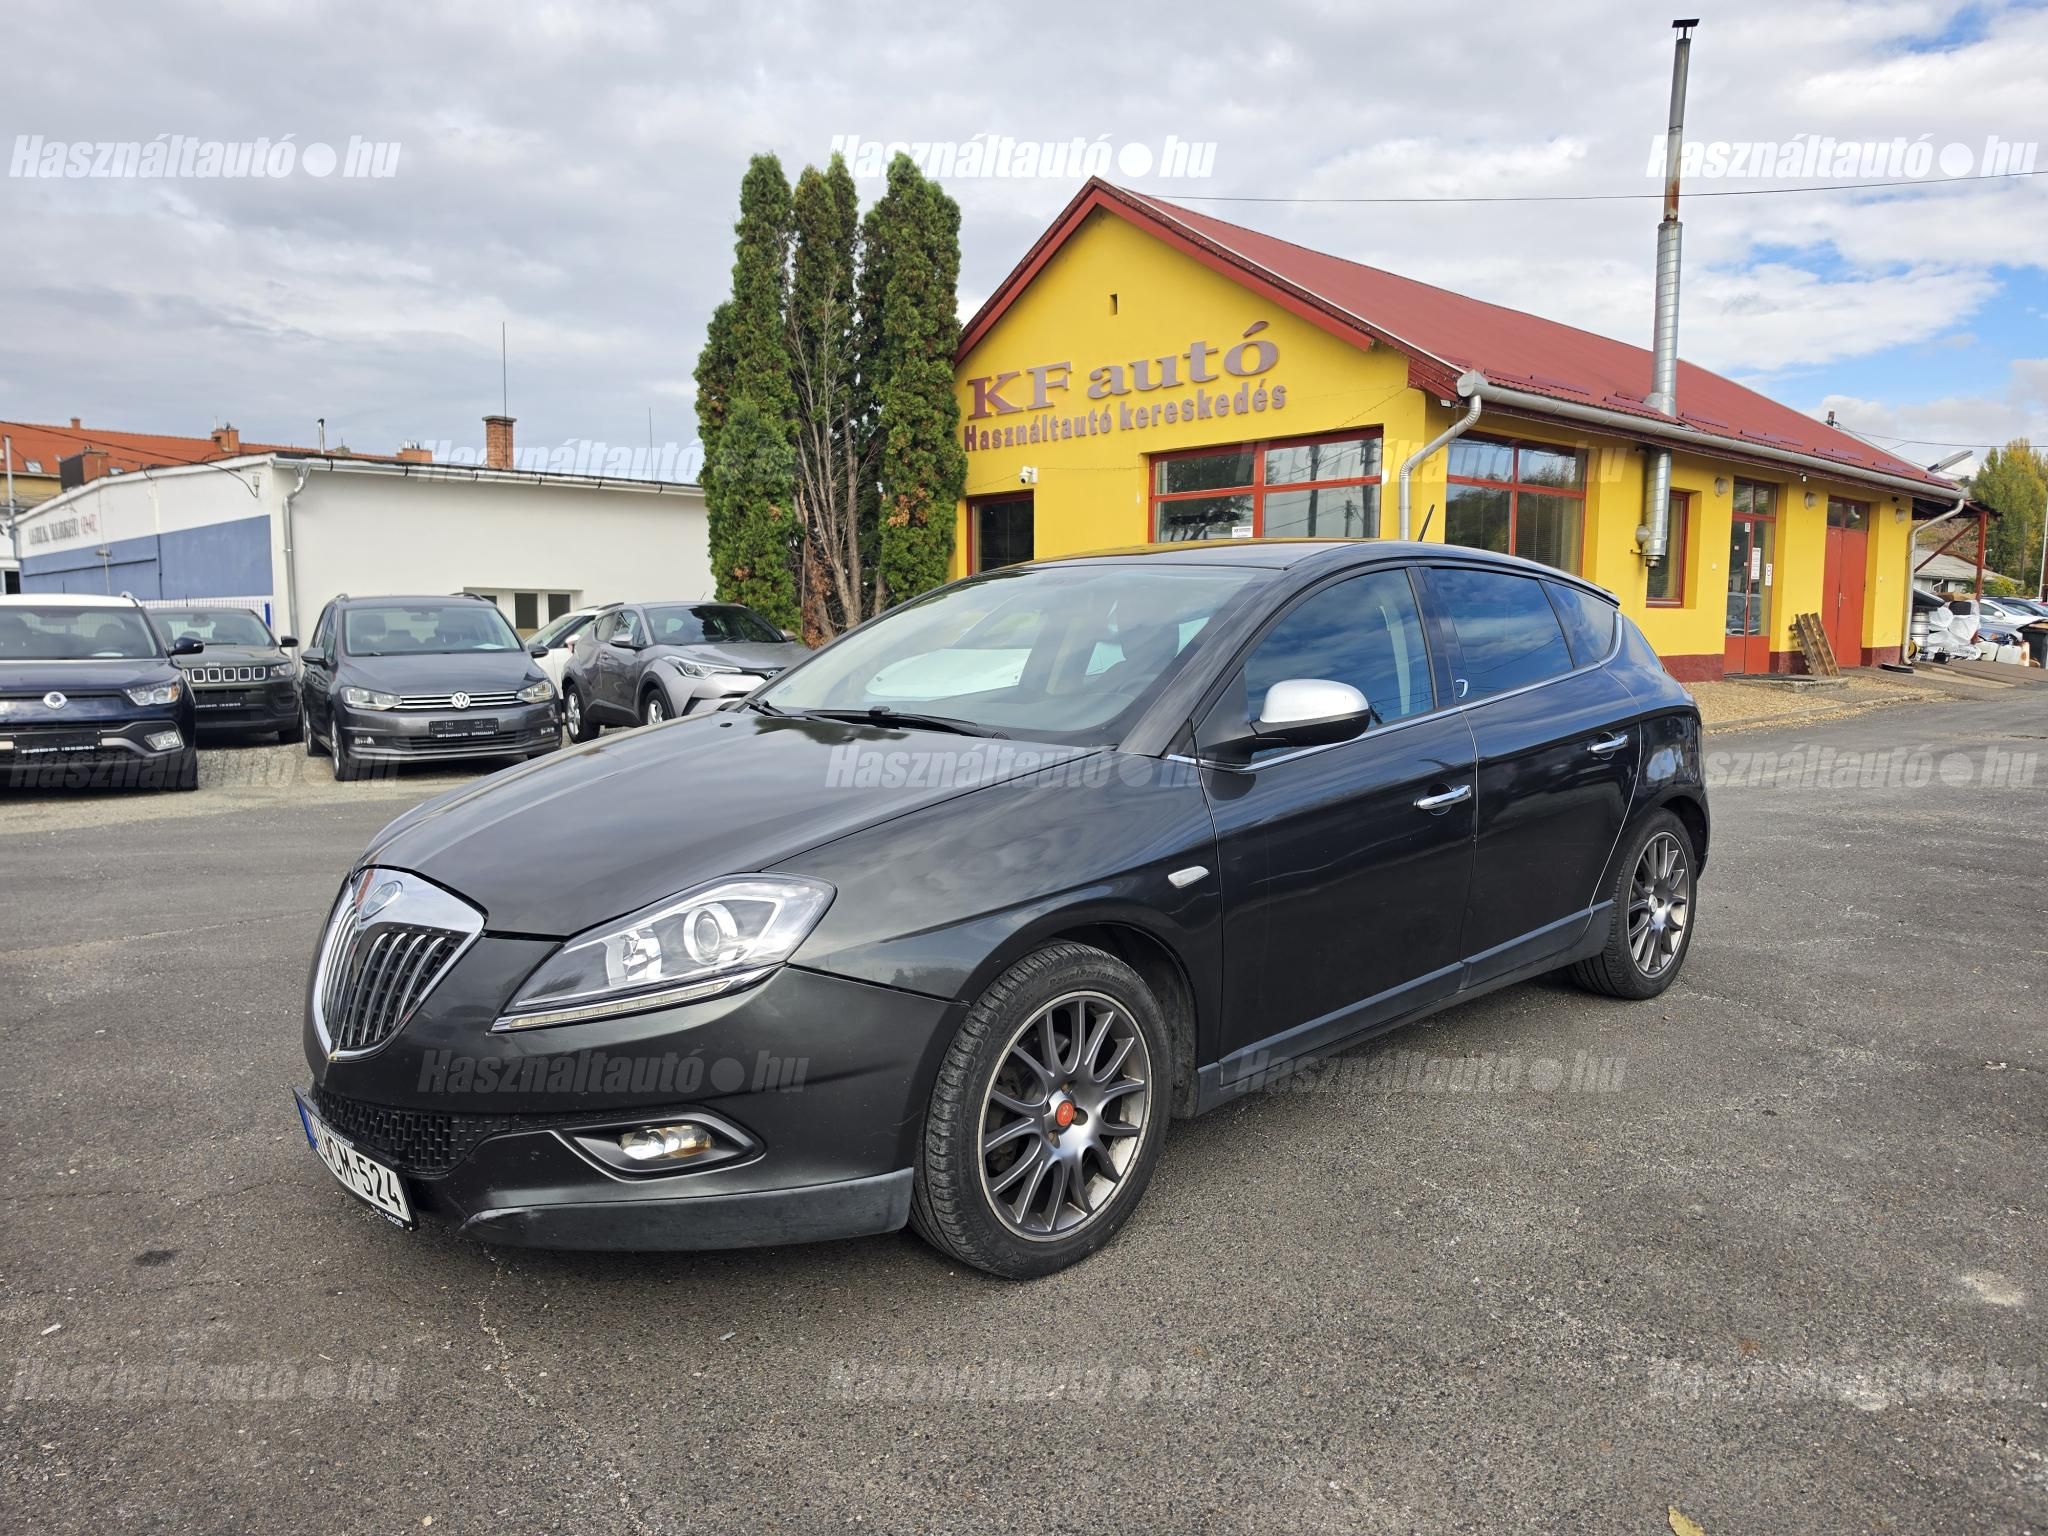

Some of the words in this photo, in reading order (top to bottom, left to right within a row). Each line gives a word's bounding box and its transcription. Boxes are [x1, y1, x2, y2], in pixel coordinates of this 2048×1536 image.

[967, 361, 1072, 421] KF
[1087, 320, 1280, 399] autó
[964, 404, 1112, 451] Használtautó
[1119, 379, 1287, 430] kereskedés
